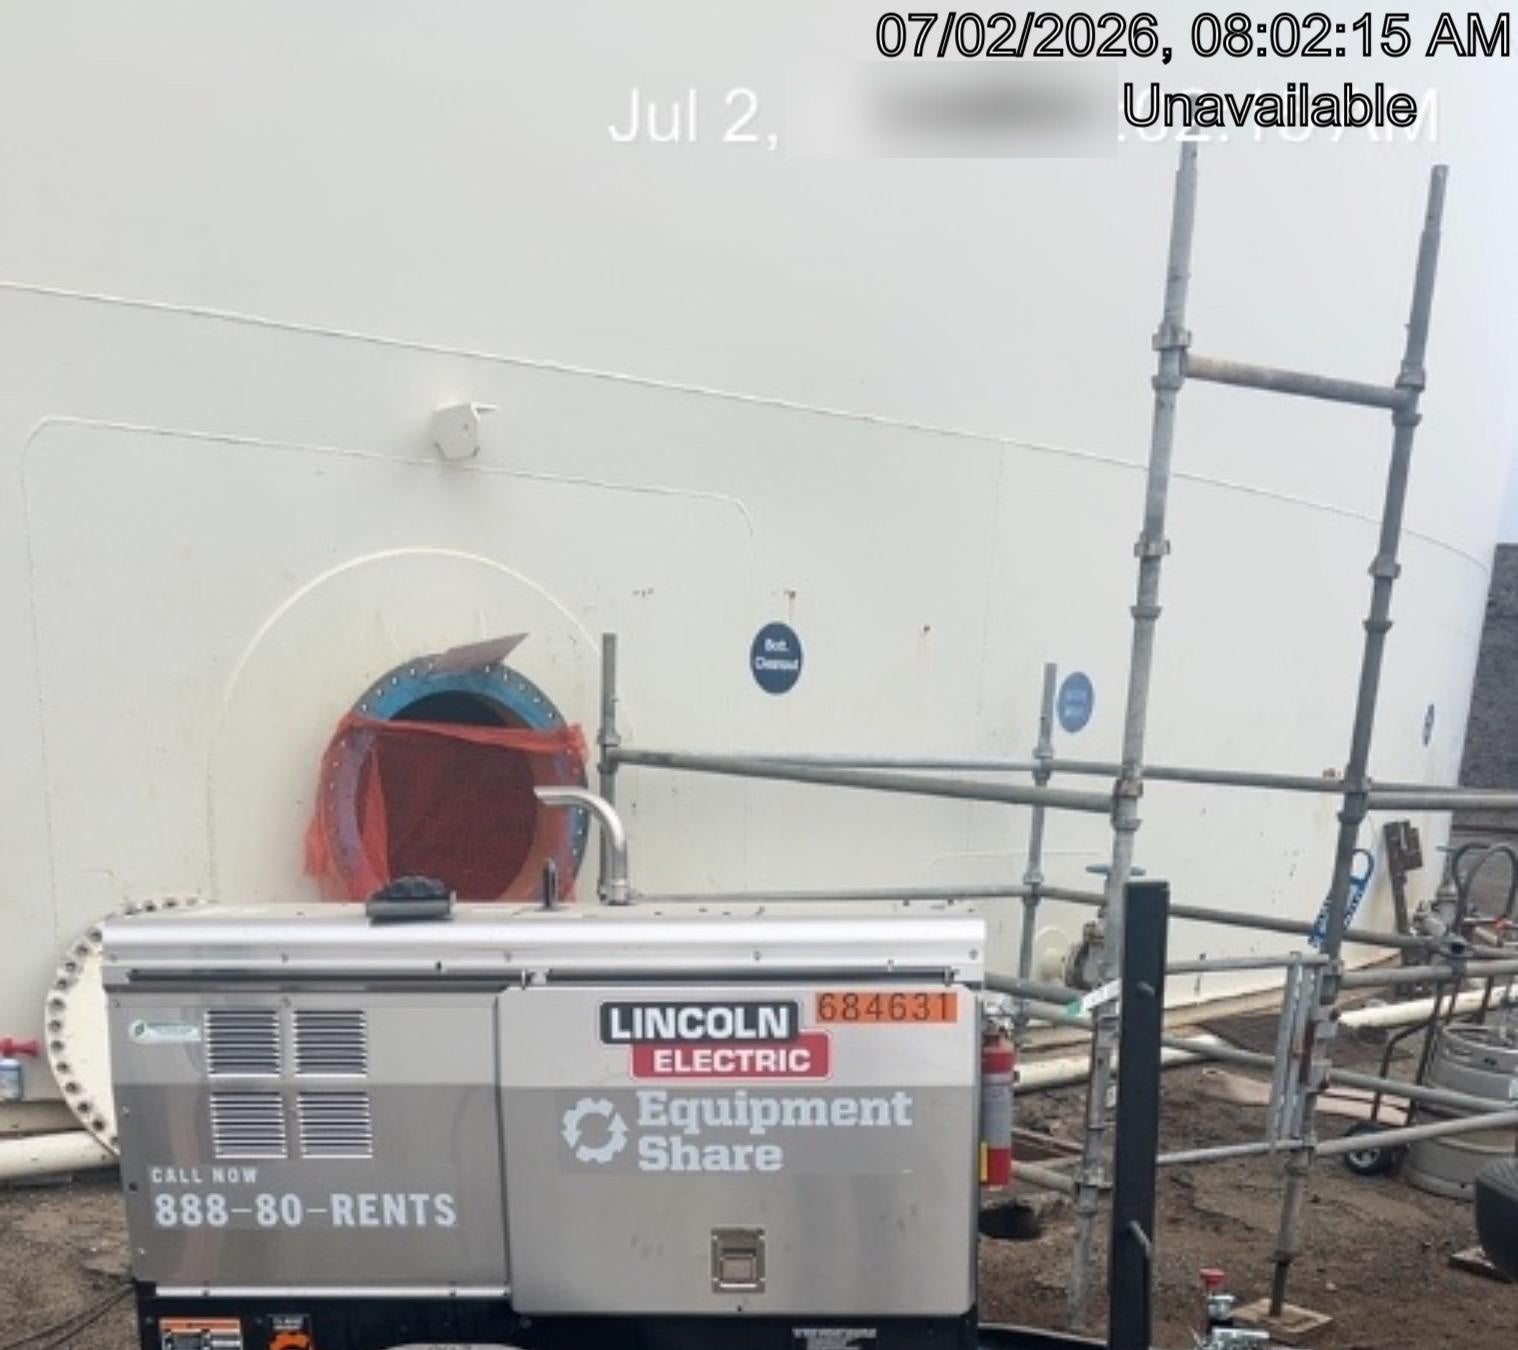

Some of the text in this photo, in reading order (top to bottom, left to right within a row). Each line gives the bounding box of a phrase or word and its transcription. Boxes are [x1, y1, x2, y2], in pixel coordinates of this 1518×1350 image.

[817, 992, 950, 1021] 684631
[610, 1007, 789, 1040] LINCOLN
[653, 1048, 812, 1073] ELECTRIC
[636, 1090, 913, 1135] Equipment
[637, 1136, 784, 1171] Share
[151, 1167, 258, 1184] CALL NOW
[154, 1193, 457, 1228] 888-80-RENTS
